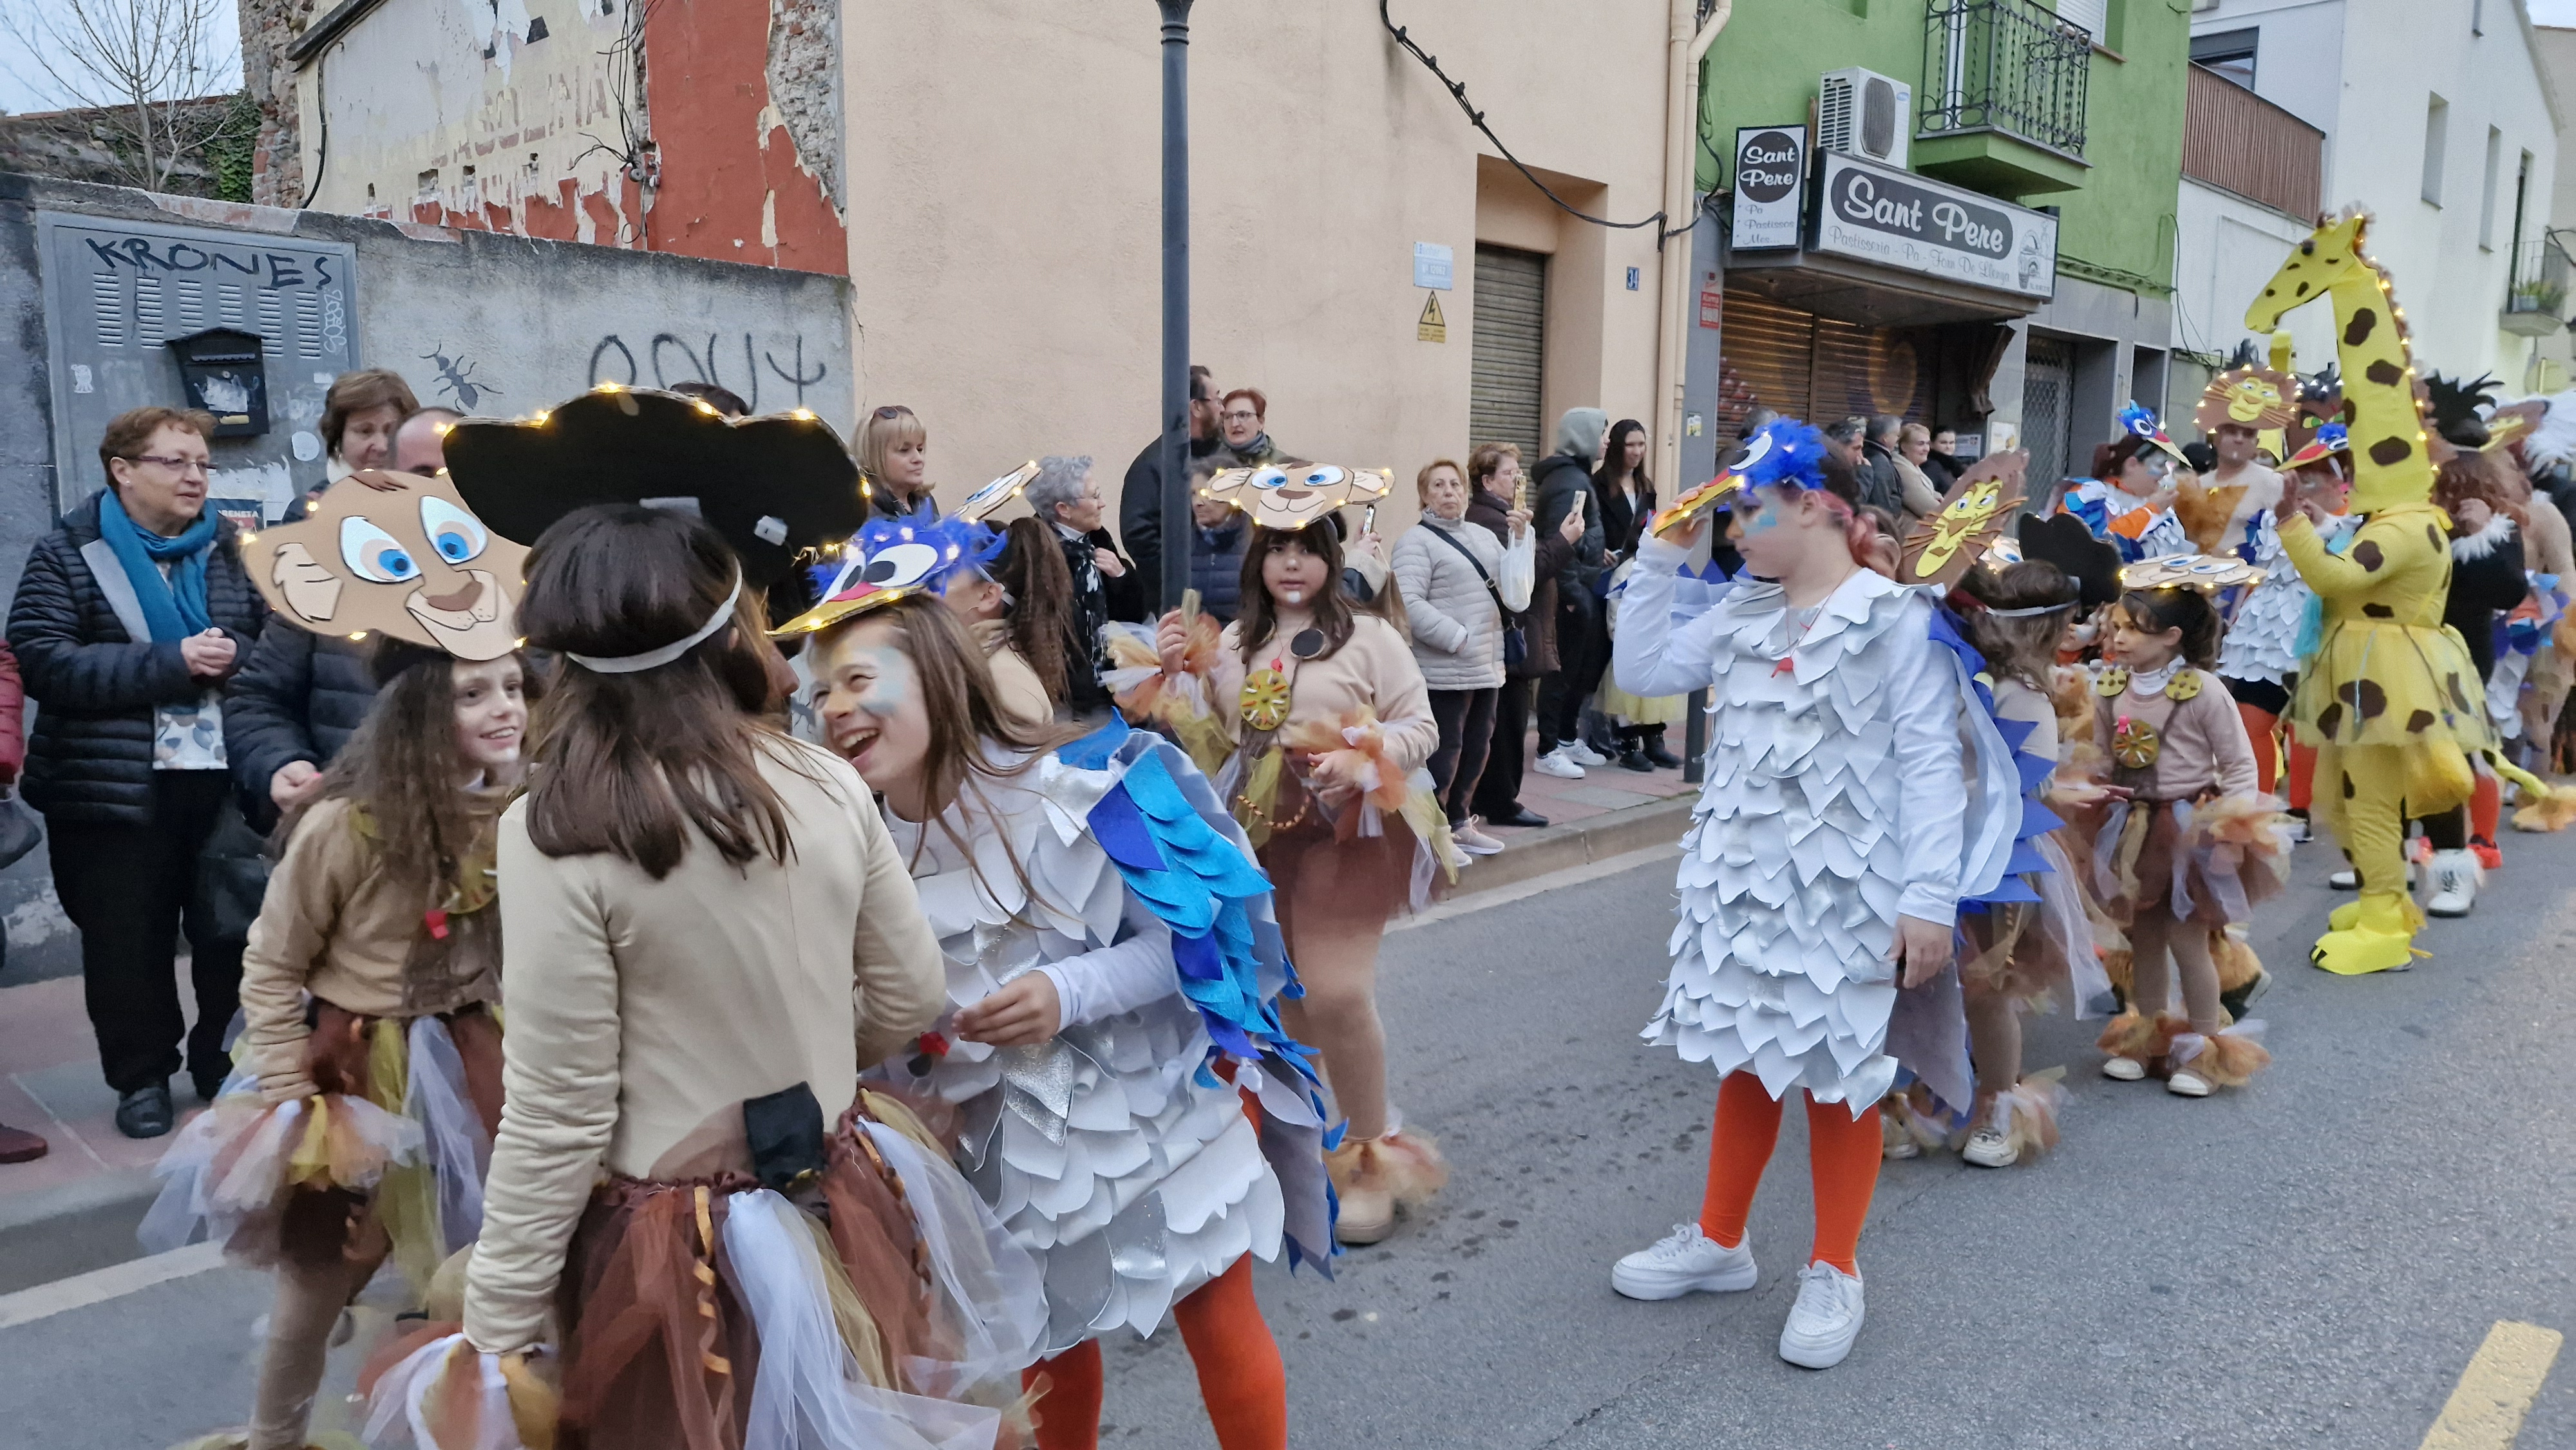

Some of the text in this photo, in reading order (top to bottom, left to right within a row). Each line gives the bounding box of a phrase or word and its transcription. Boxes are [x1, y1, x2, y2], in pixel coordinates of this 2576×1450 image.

[1744, 146, 1795, 165] Sant
[1739, 169, 1794, 187] Pere
[1745, 203, 1763, 214] Pa
[1844, 174, 2003, 253] Sant Pere
[1744, 219, 1795, 229] Pastissos
[1828, 225, 1890, 255] Pastisseria
[1902, 243, 1919, 261] Pa
[1958, 256, 1975, 274] De
[85, 238, 332, 291] KRONES
[1627, 268, 1638, 288] 34
